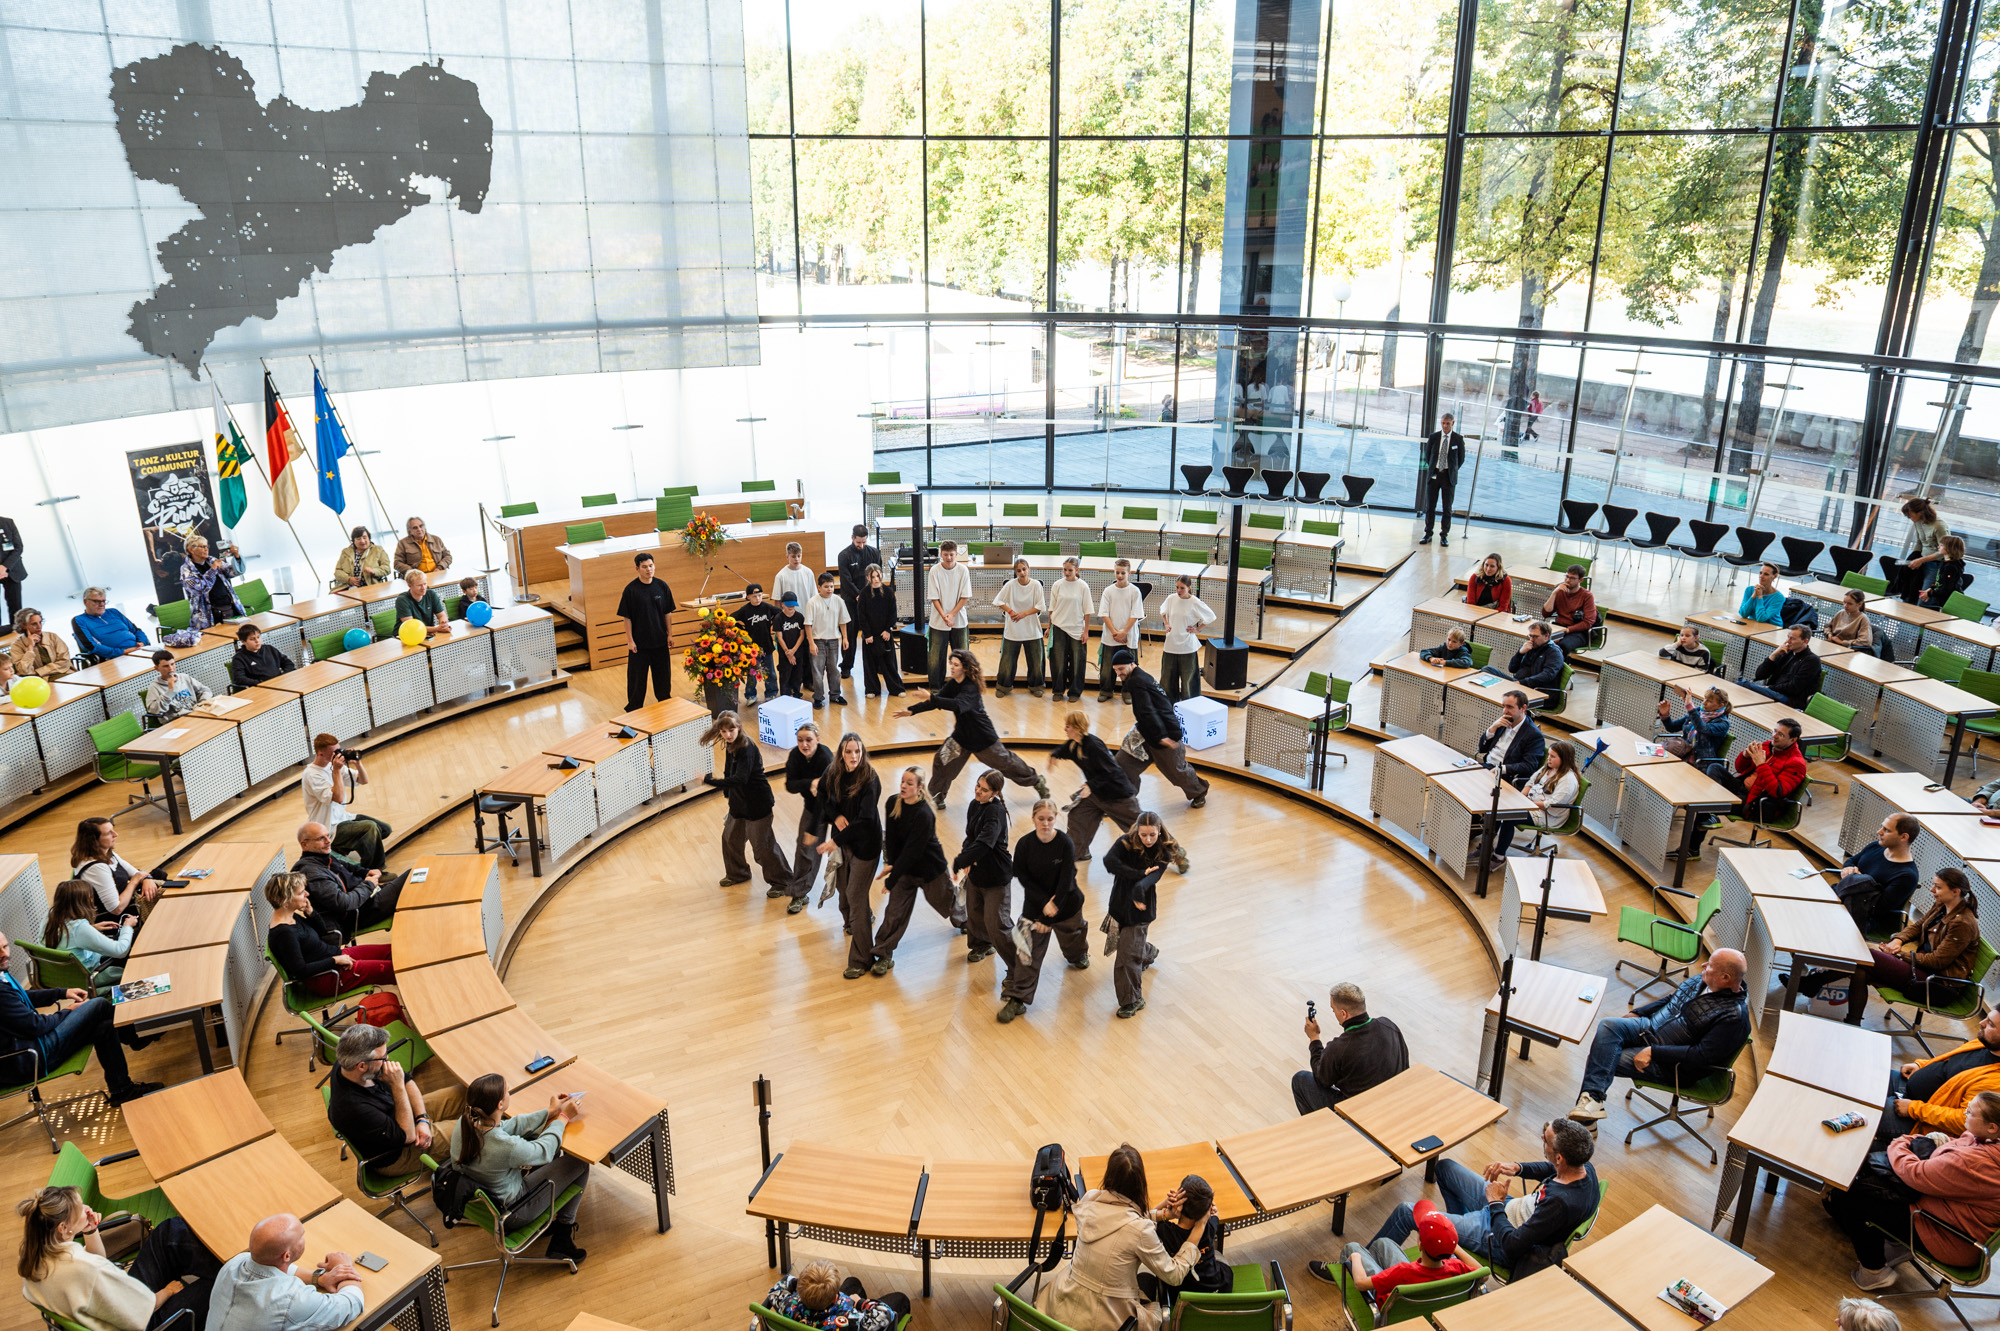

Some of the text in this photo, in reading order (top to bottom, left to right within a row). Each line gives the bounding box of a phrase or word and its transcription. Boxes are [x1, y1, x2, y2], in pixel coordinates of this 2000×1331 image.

[133, 450, 199, 467] TANZ KULTUR
[141, 460, 196, 475] COMMUNITY
[759, 716, 771, 726] THE
[760, 734, 776, 744] SEEN
[1819, 989, 1846, 1000] AfD
